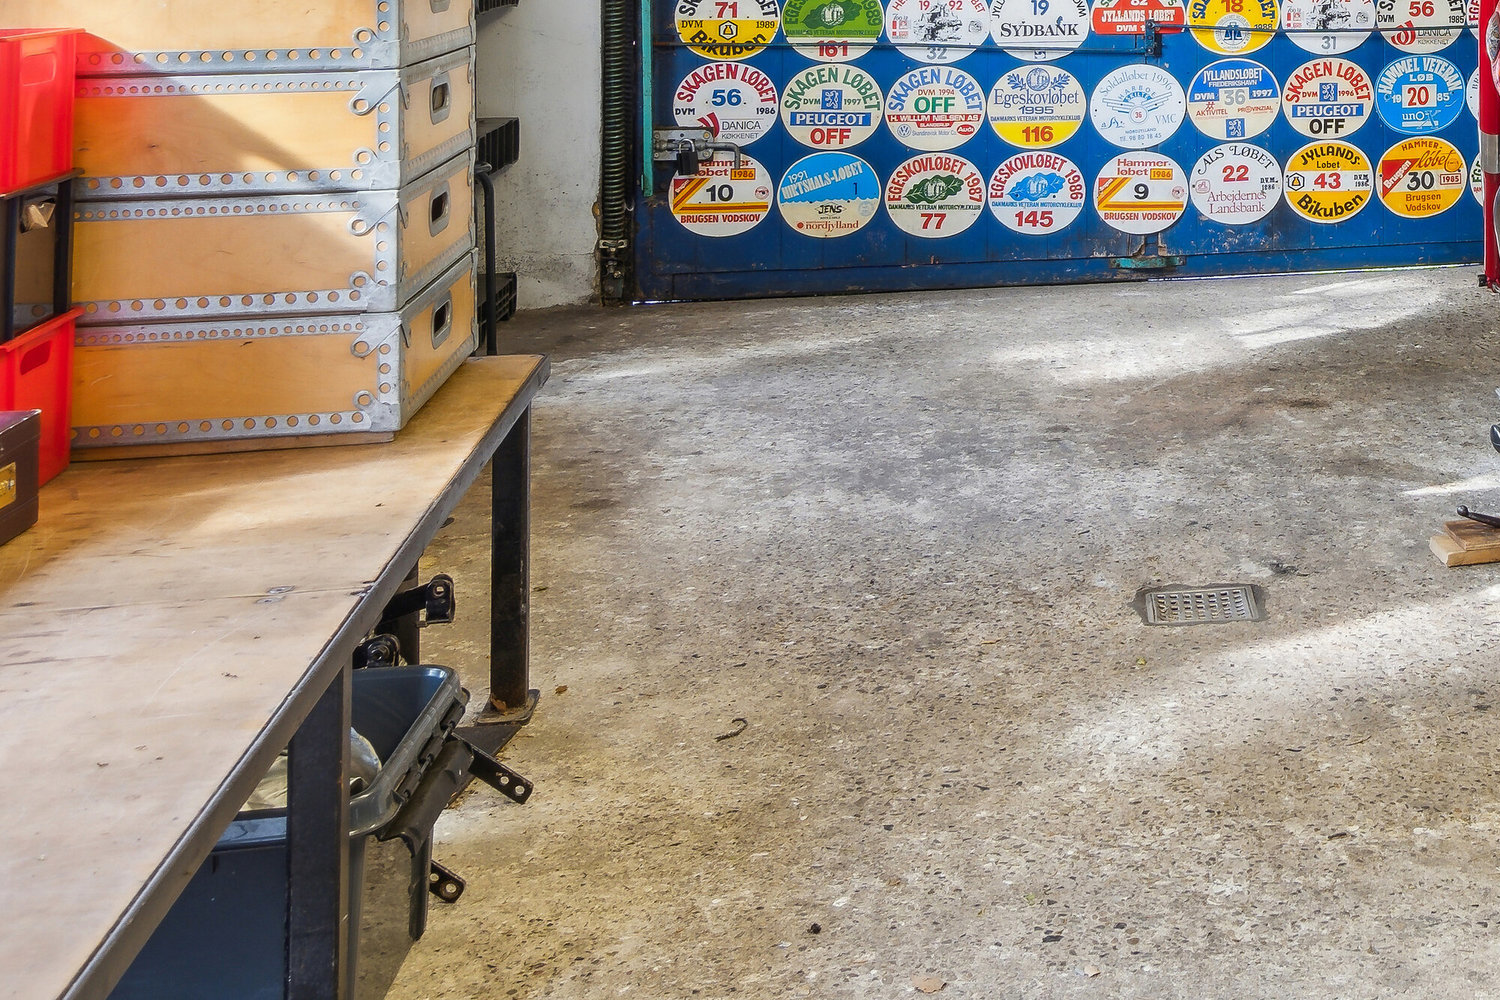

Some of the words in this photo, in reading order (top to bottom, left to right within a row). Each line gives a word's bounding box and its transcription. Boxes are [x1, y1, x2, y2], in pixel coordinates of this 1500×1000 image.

[715, 2, 738, 18] 71
[1031, 0, 1050, 16] 19
[1408, 1, 1434, 17] 56
[1000, 16, 1079, 38] SYDBANK
[1203, 68, 1263, 83] JYLLANDSLØBET
[678, 64, 738, 103] SKAGEN
[741, 65, 776, 106] LØBET
[712, 89, 742, 106] 56
[994, 88, 1079, 108] Egeskovløbet
[1224, 88, 1246, 105] 36
[1407, 87, 1430, 106] 20
[914, 97, 956, 113] OFF
[1296, 105, 1359, 116] PEUGEOT
[722, 121, 762, 130] DANICA
[1308, 118, 1346, 134] OFF
[810, 128, 852, 144] OFF
[1022, 126, 1054, 142] 116
[1314, 173, 1342, 189] 43
[1407, 171, 1434, 190] 30
[706, 184, 734, 202] 10
[1296, 194, 1364, 217] Bikuben
[680, 214, 720, 223] BRUGSEN
[722, 214, 760, 222] VODSKOV
[1014, 211, 1054, 227] 145
